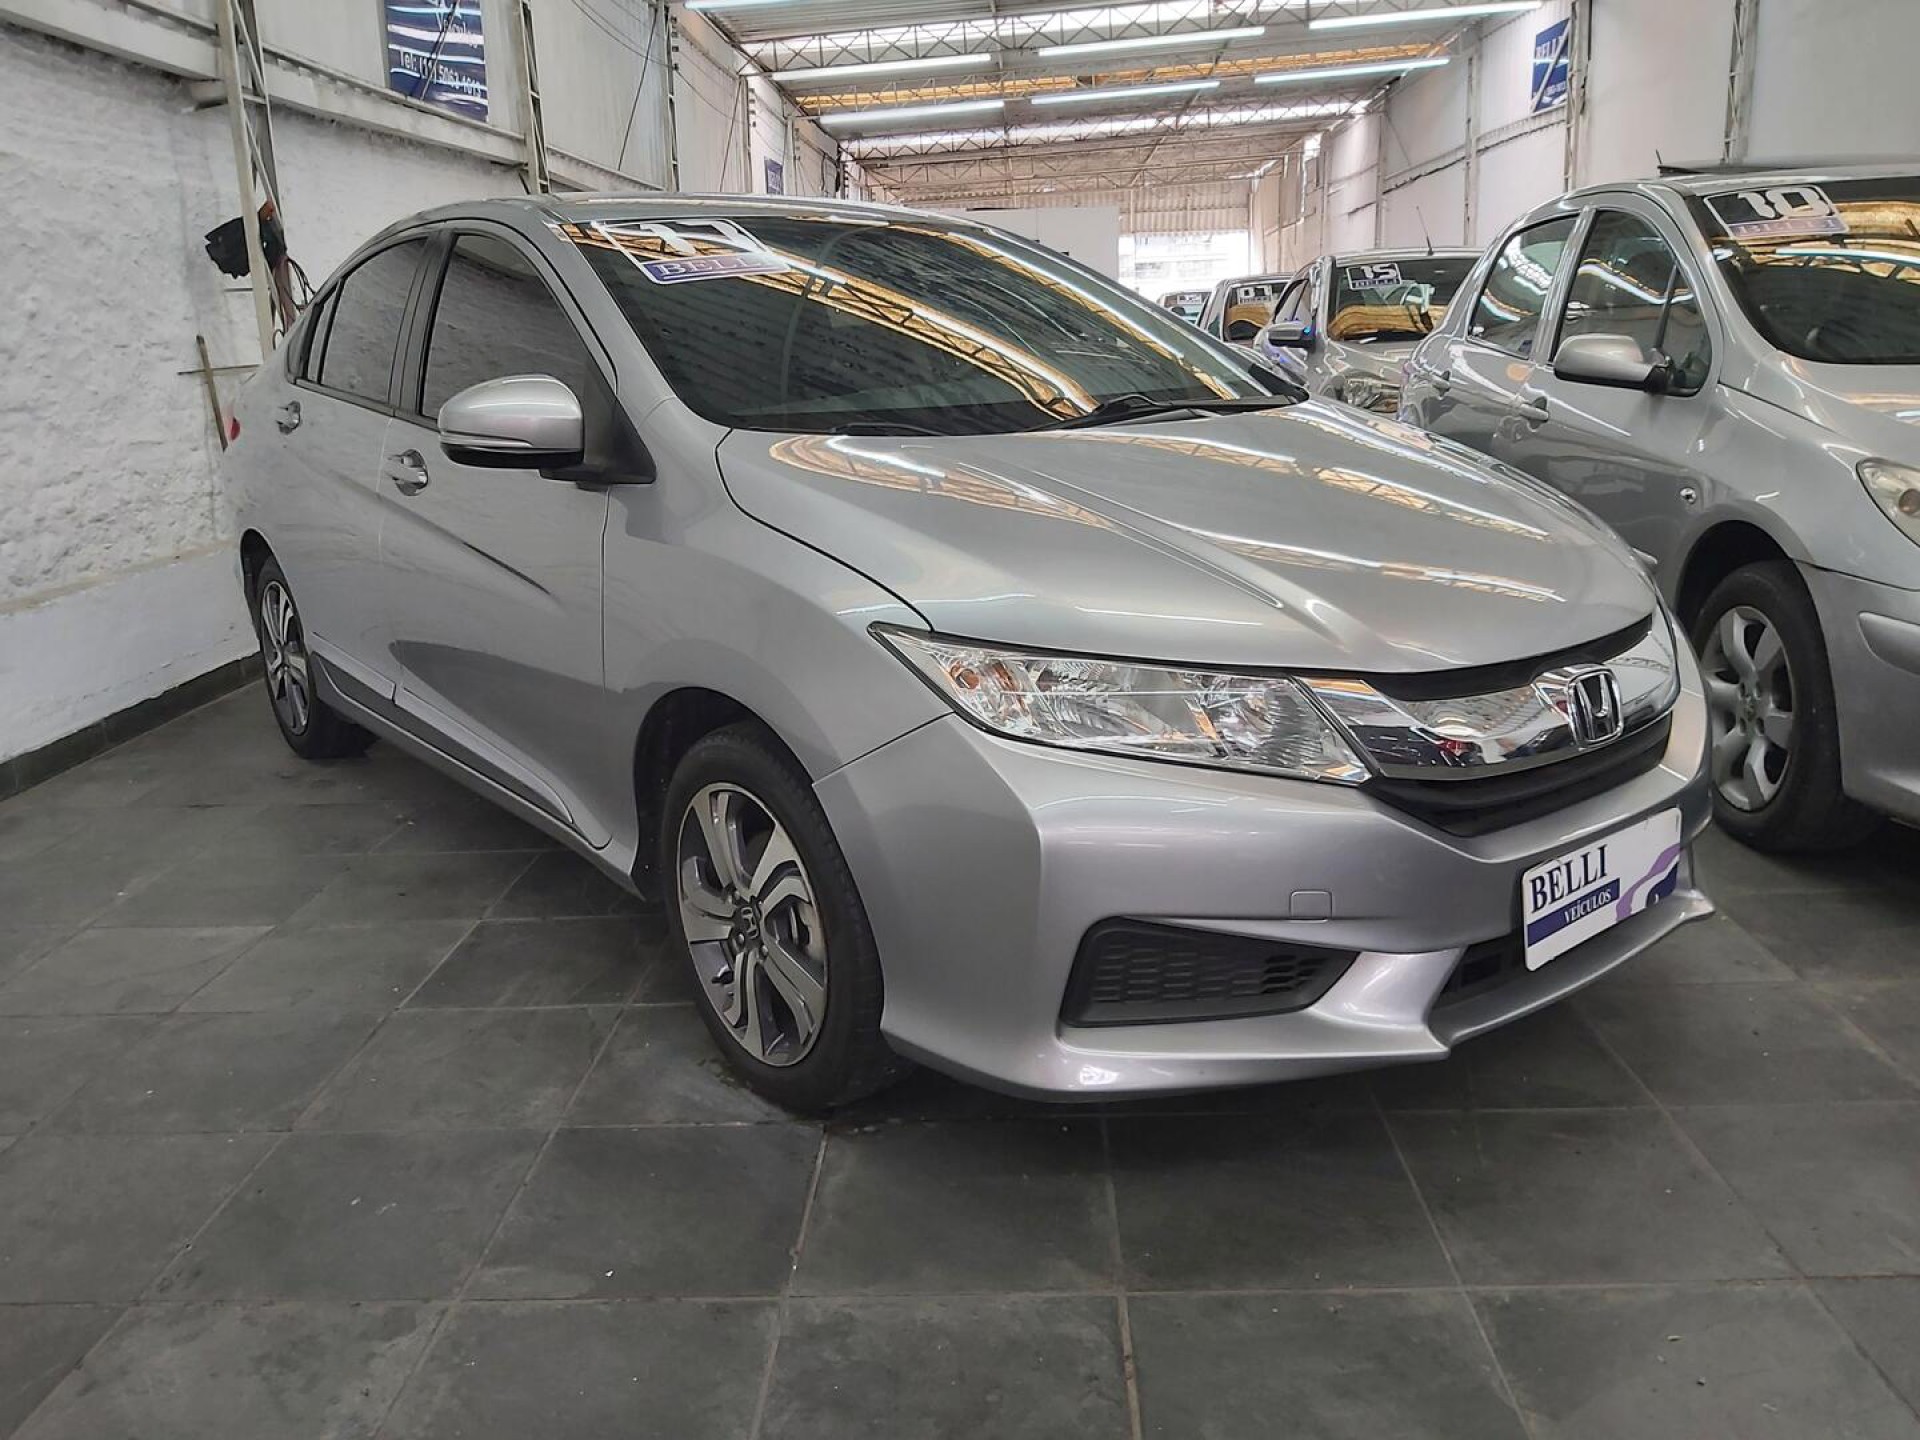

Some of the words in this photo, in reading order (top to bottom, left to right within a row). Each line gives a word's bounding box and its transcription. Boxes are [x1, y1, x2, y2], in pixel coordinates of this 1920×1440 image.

[1737, 186, 1832, 219] 10
[653, 254, 768, 275] BELL
[1360, 263, 1397, 280] 15
[1529, 844, 1607, 913] BELLI
